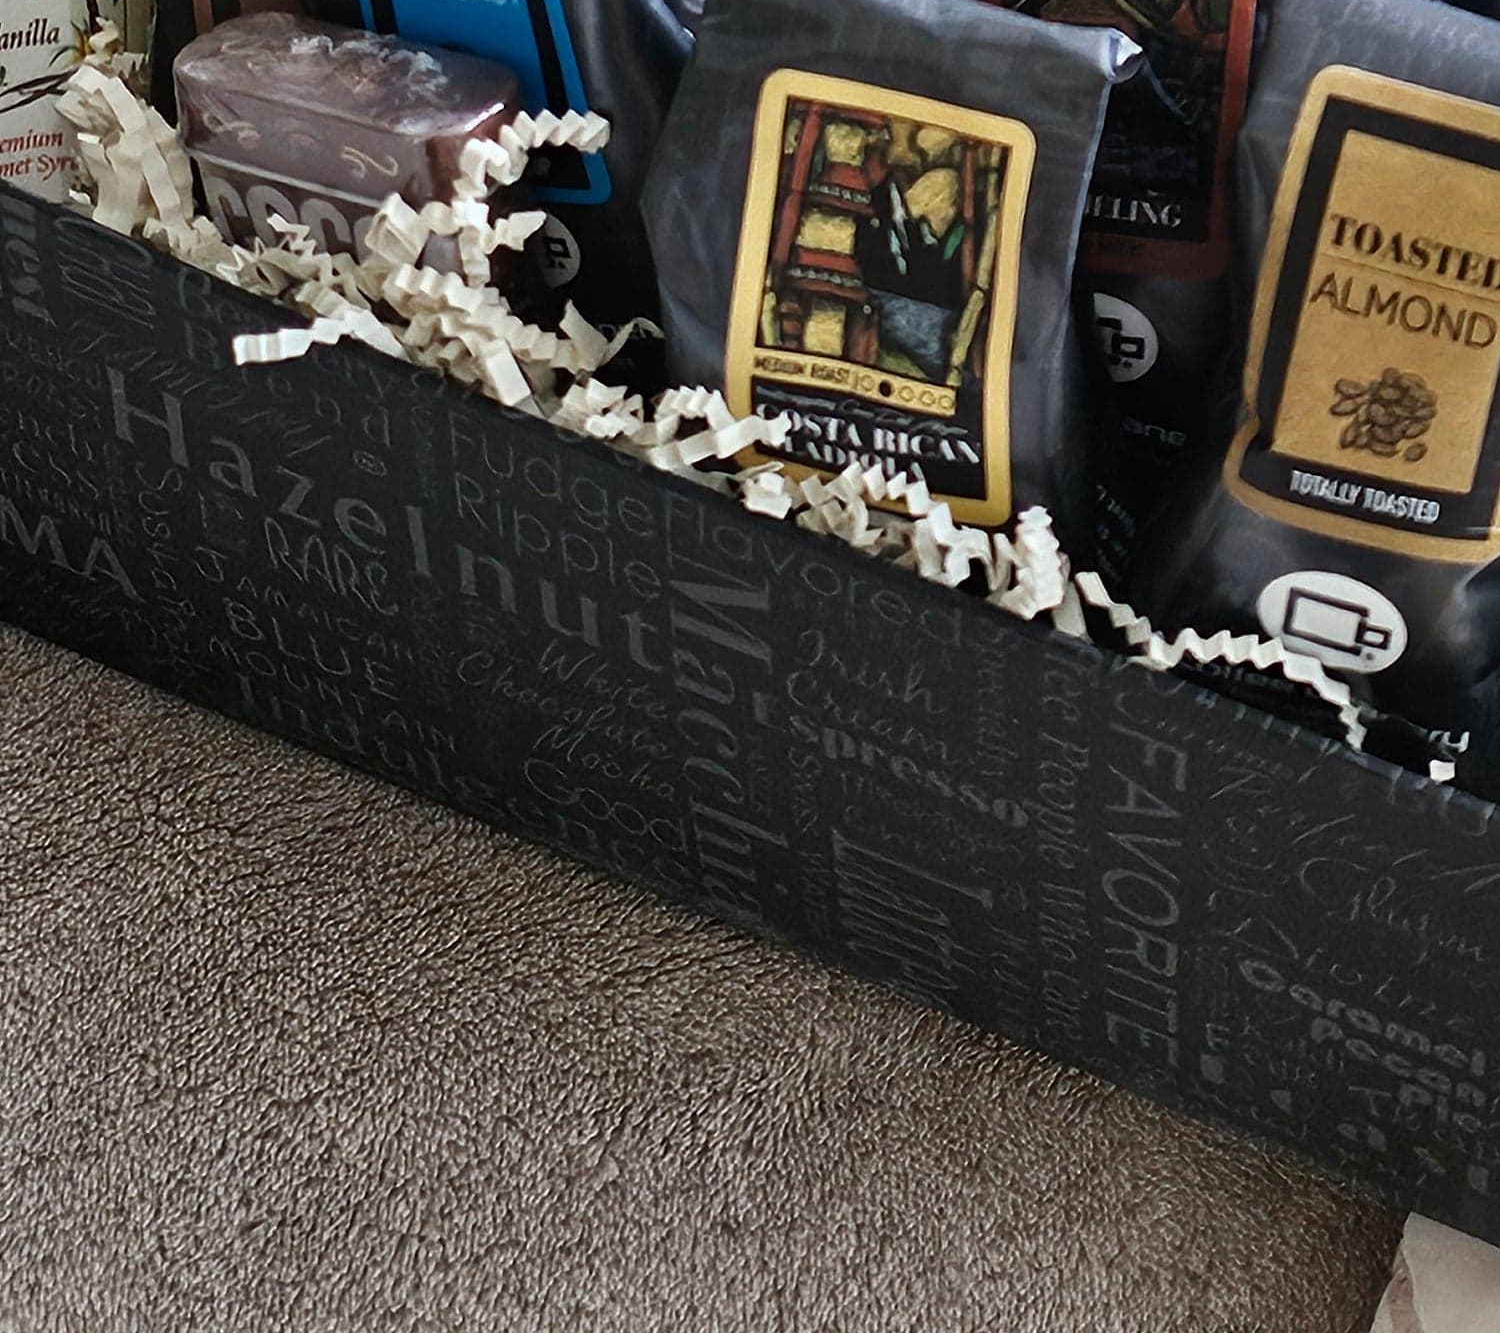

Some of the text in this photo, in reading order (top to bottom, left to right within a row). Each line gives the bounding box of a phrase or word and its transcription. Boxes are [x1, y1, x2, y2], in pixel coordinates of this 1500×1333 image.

[1308, 271, 1499, 350] ALMOND
[449, 408, 656, 539] Fudge
[872, 427, 981, 465] RICAN
[1289, 469, 1441, 525] TOTALLY TOASTED
[106, 365, 662, 673] Hazelnut
[454, 470, 663, 601] Ripple
[662, 489, 963, 649] Flavored
[225, 597, 400, 703] BLUE
[1101, 721, 1189, 1068] FAVORITE
